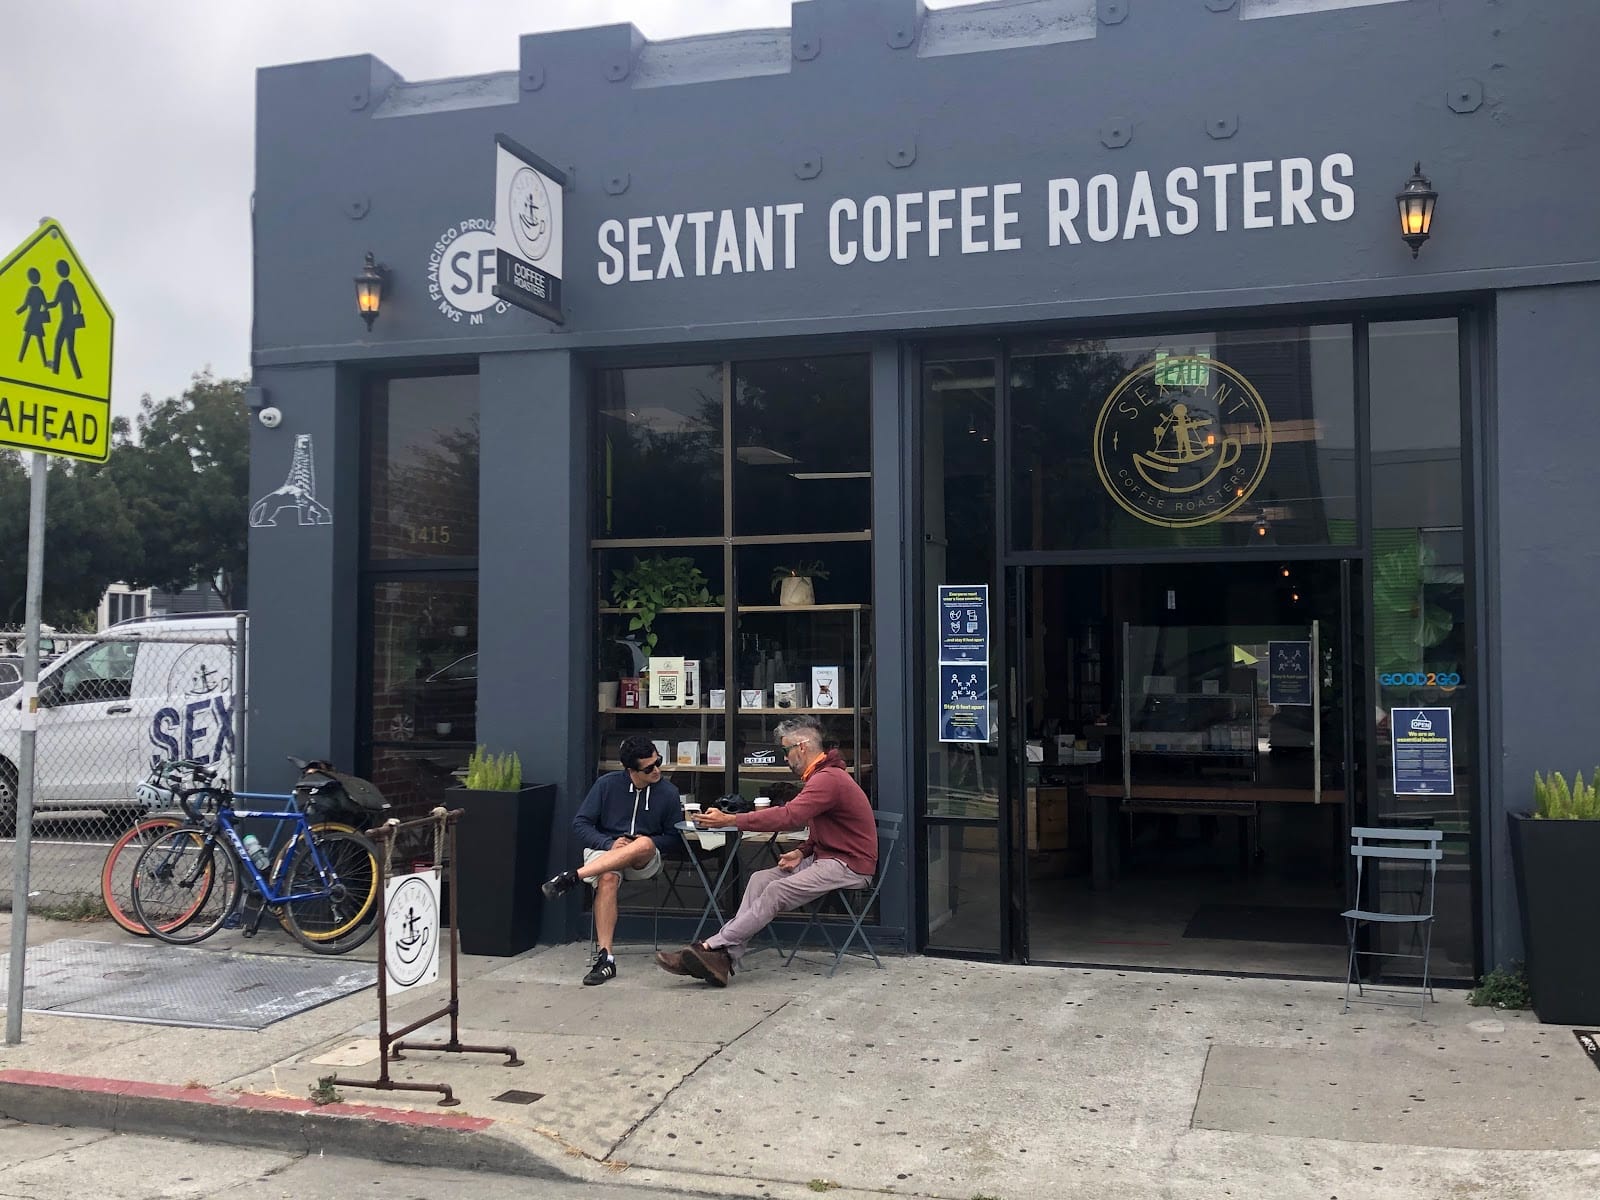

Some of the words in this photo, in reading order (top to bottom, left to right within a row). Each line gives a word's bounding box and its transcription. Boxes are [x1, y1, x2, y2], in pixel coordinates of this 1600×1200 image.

[459, 218, 496, 232] PROU
[597, 203, 804, 286] SEXTANT
[828, 182, 1022, 266] COFFEE
[1047, 152, 1355, 247] ROASTERS
[428, 228, 457, 300] FRANCISCO
[451, 250, 496, 295] SF
[514, 262, 545, 289] COFFEE
[513, 275, 546, 299] ROASTERS
[438, 301, 463, 322] SAN
[470, 313, 483, 326] IN
[0, 397, 98, 445] AHEAD
[1118, 469, 1165, 509] COFFEE
[1175, 466, 1246, 511] ROASTERS
[408, 525, 450, 544] 1415
[1380, 672, 1461, 686] GOOD2GO
[744, 756, 776, 764] COFFEE
